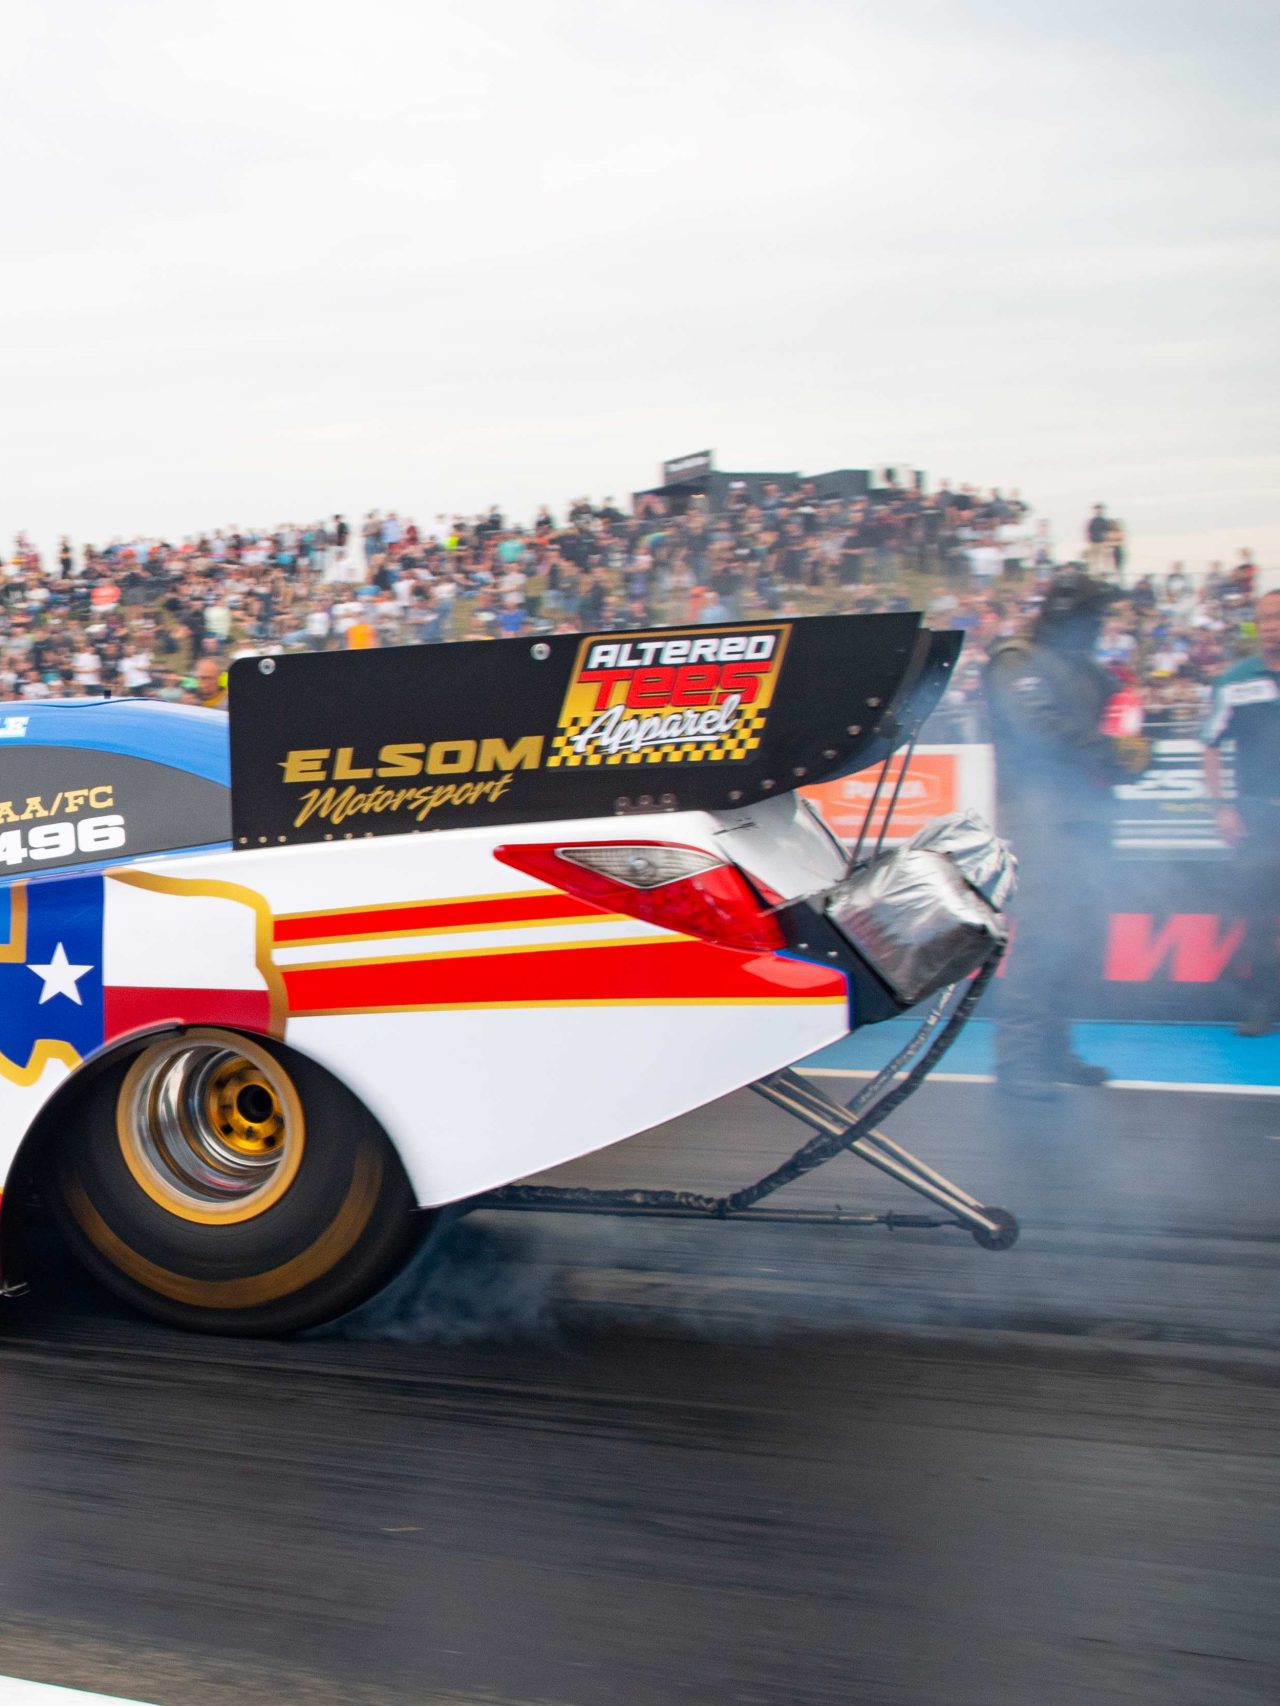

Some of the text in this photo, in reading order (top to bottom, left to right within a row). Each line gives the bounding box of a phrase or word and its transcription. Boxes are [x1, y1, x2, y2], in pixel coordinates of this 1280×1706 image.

[570, 693, 742, 754] Apparel
[276, 735, 545, 783] ELSOM
[290, 773, 514, 828] Motorsport
